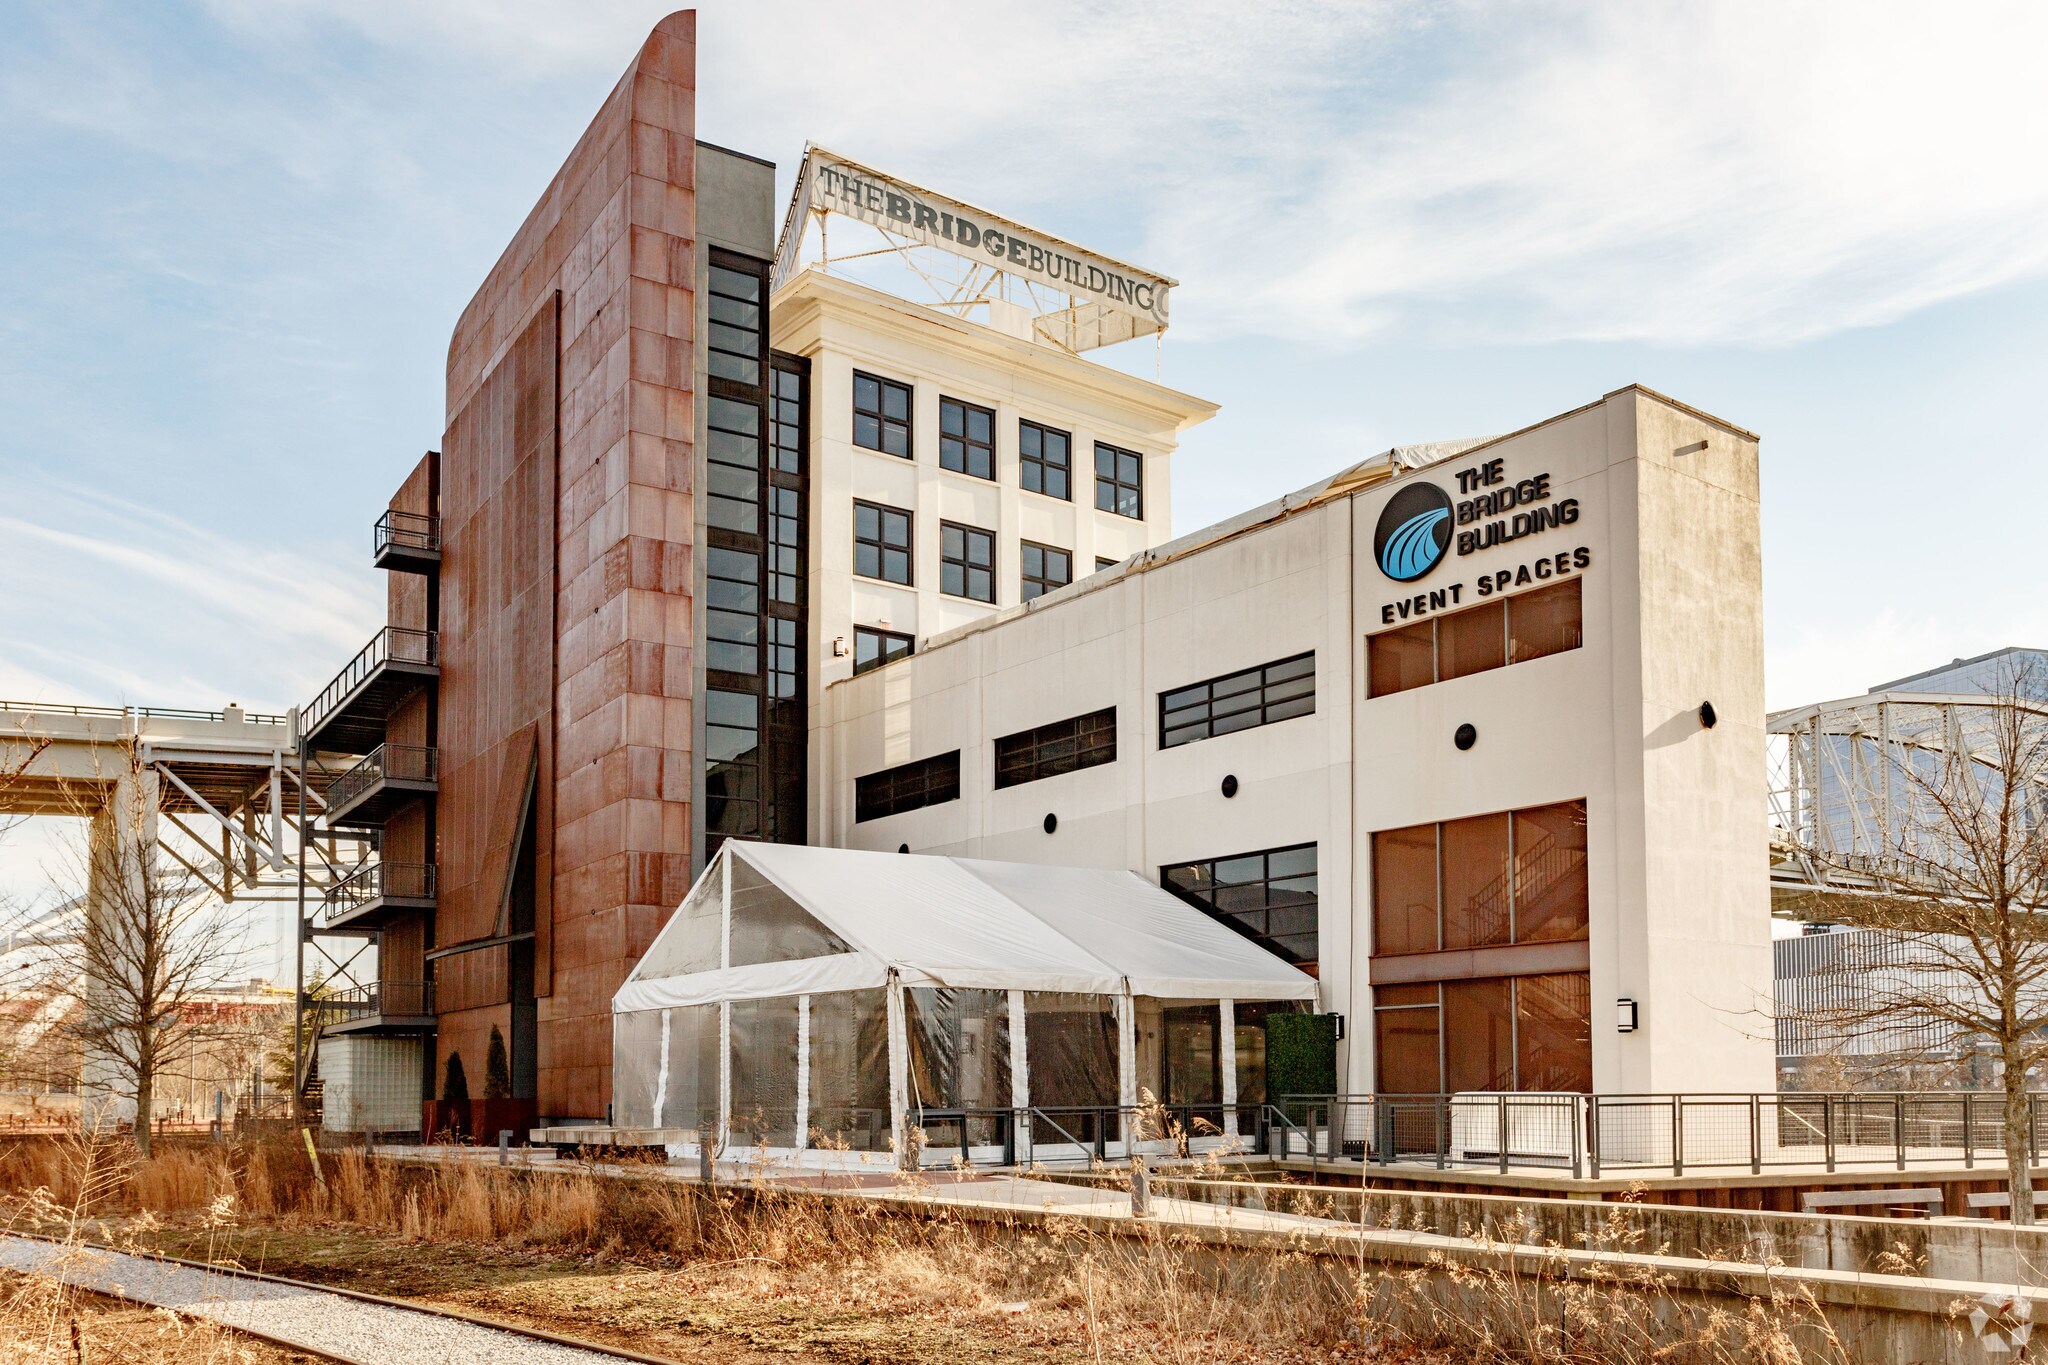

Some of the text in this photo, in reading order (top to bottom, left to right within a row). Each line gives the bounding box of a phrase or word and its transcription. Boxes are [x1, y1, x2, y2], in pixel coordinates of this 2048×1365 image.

[1455, 457, 1504, 495] THE
[1457, 472, 1551, 526] BRIDGE
[1457, 498, 1580, 557] BUILDING
[1381, 546, 1591, 625] EVENT SPACES
